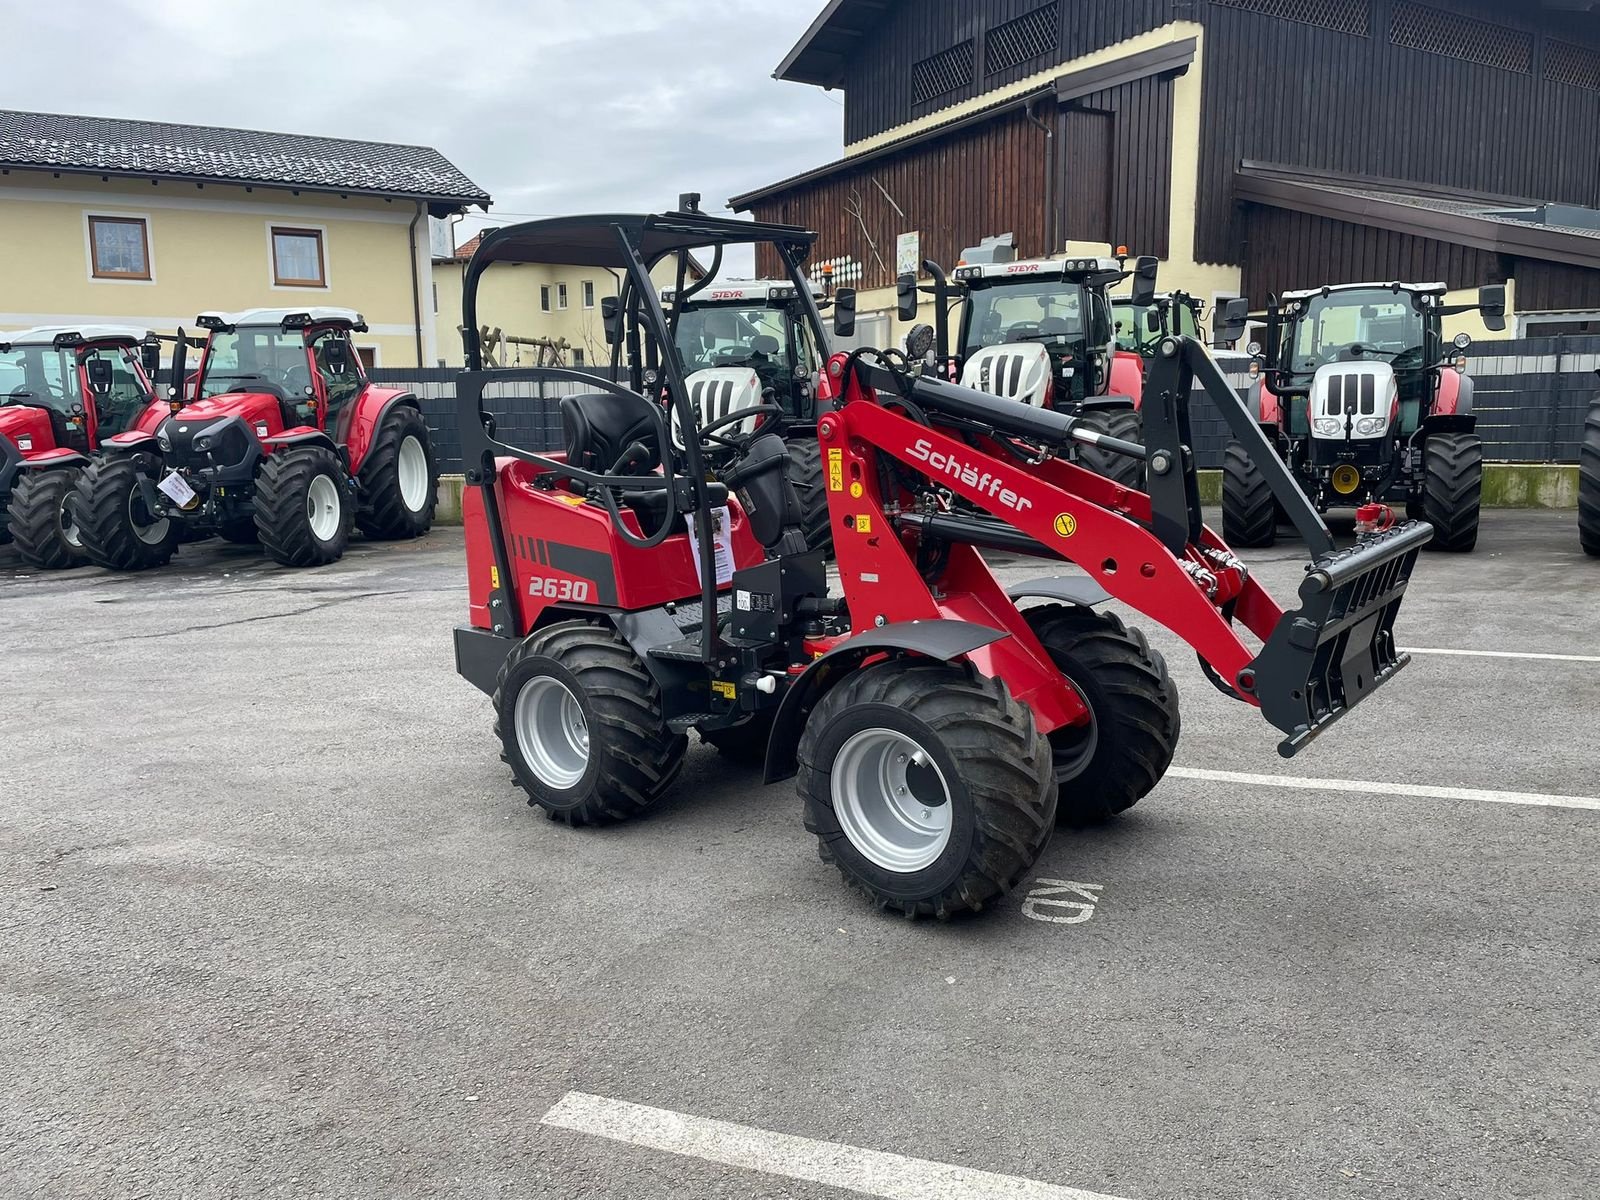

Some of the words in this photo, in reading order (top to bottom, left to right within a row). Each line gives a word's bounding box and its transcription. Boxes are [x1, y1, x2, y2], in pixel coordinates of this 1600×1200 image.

[1007, 263, 1039, 273] STEYR
[711, 290, 743, 299] STEYR
[905, 438, 1033, 512] Schäffer
[529, 576, 588, 602] 2630
